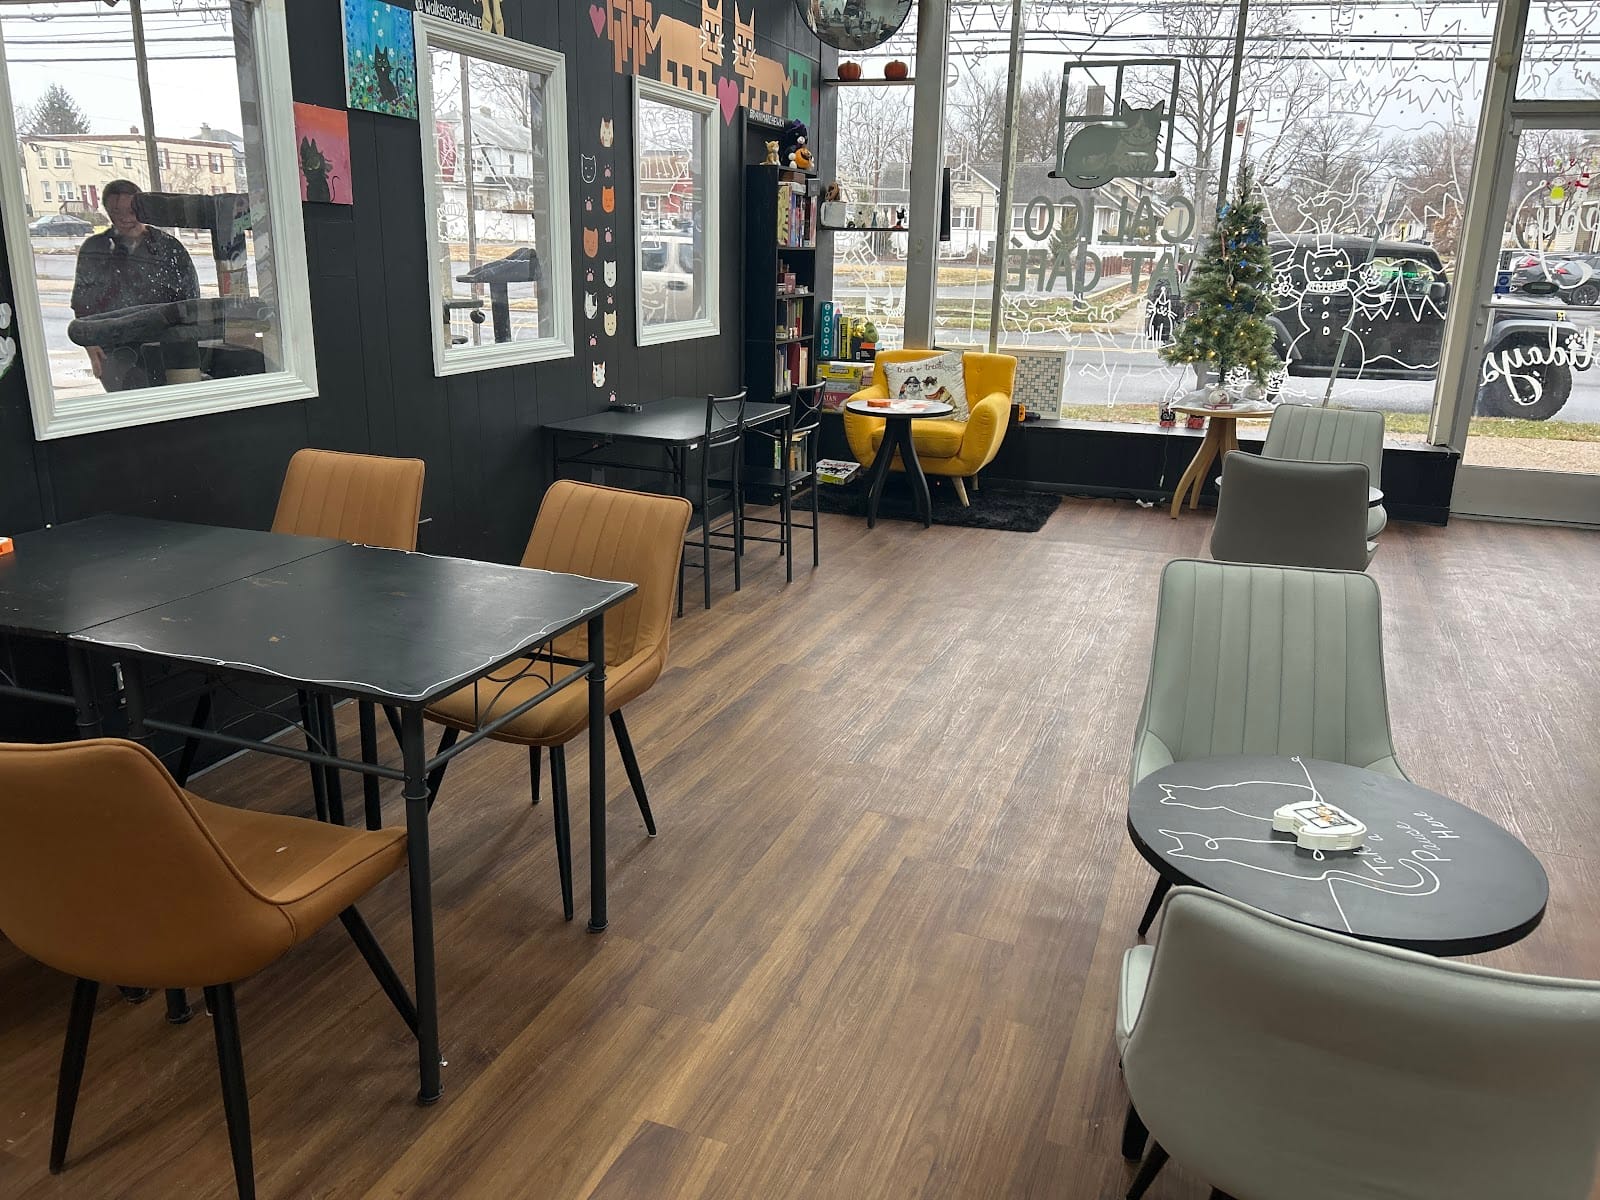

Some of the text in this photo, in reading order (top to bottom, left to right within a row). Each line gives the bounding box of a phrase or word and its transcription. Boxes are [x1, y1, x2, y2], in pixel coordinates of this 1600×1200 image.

[822, 393, 838, 402] ATAN
[1367, 833, 1384, 842] a
[1412, 810, 1461, 839] Here
[1396, 820, 1453, 862] Pause
[1352, 843, 1395, 877] Tak
